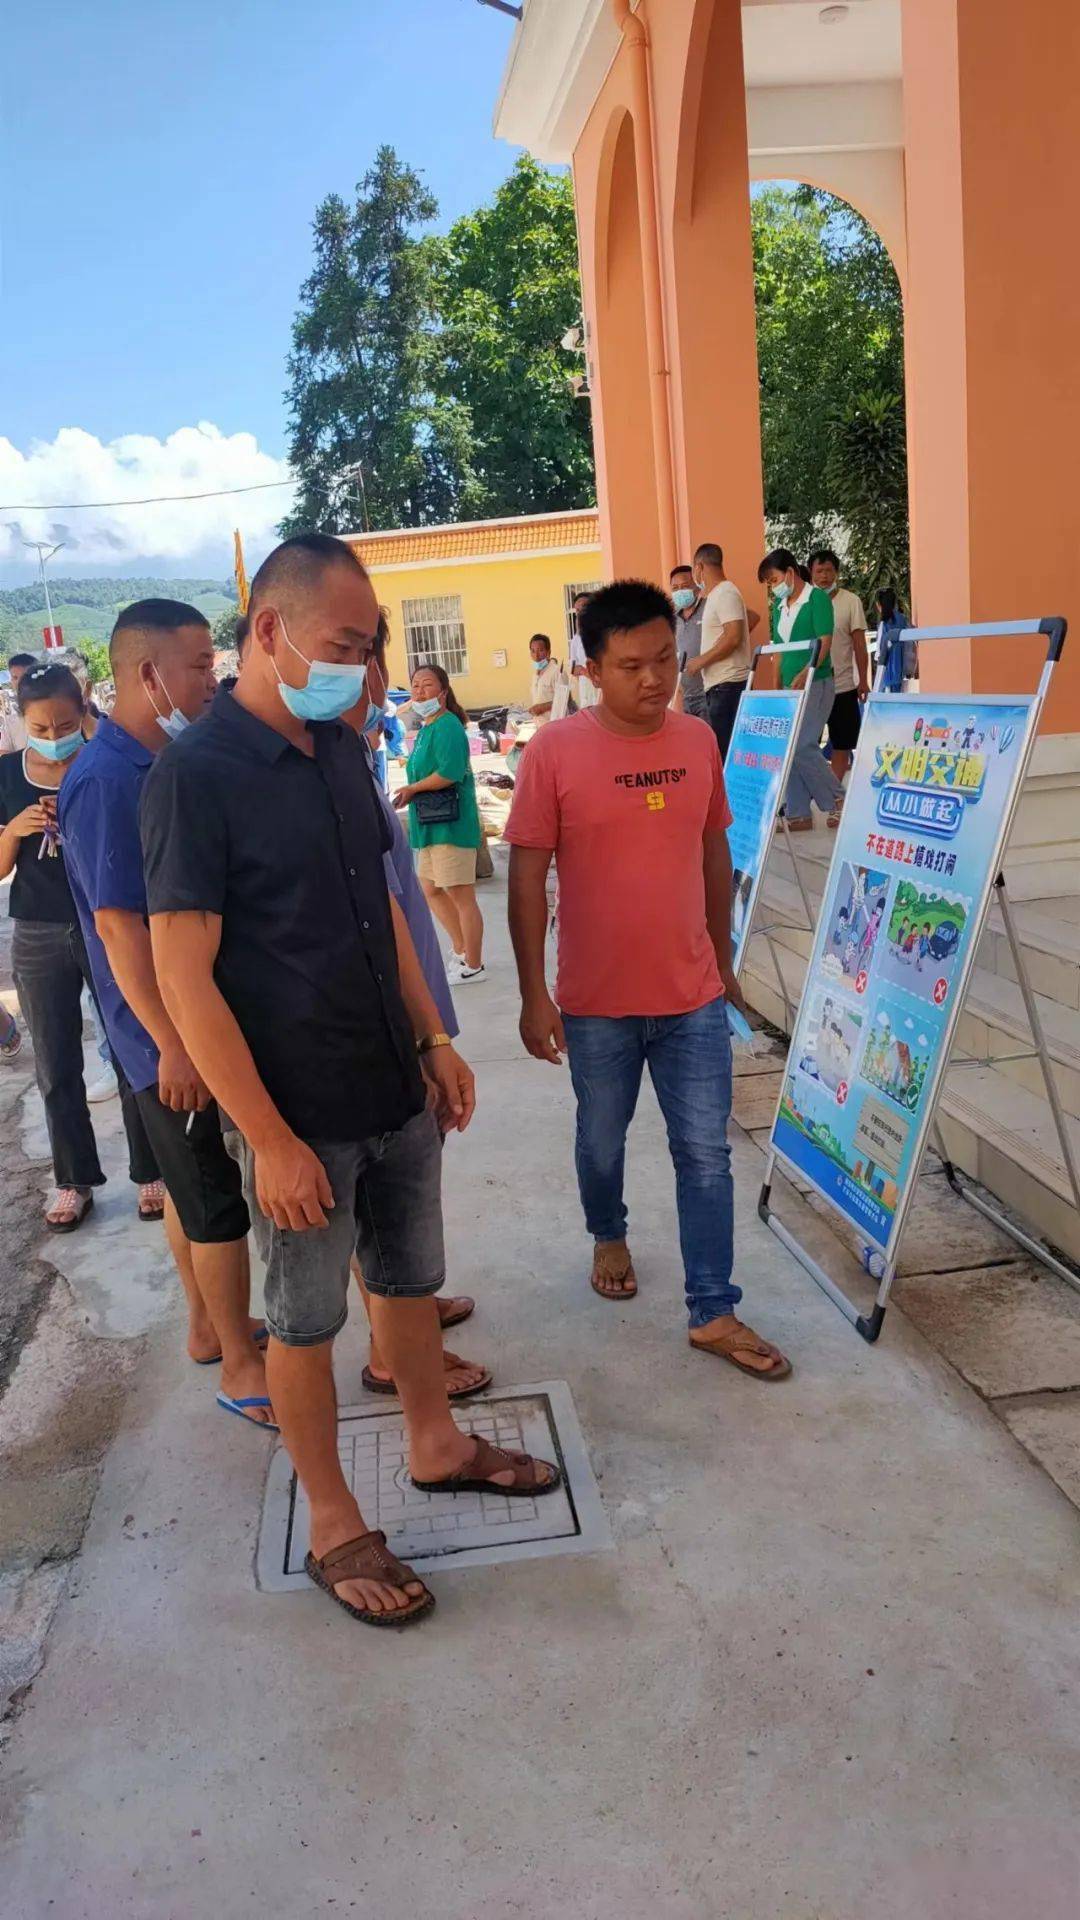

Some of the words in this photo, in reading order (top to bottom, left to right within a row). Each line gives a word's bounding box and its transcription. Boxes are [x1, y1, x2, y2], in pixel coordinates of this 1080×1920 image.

[872, 742, 987, 791] 文明交通
[884, 791, 956, 820] 从小做起
[866, 833, 957, 876] 不在道路上嬉戏打闹
